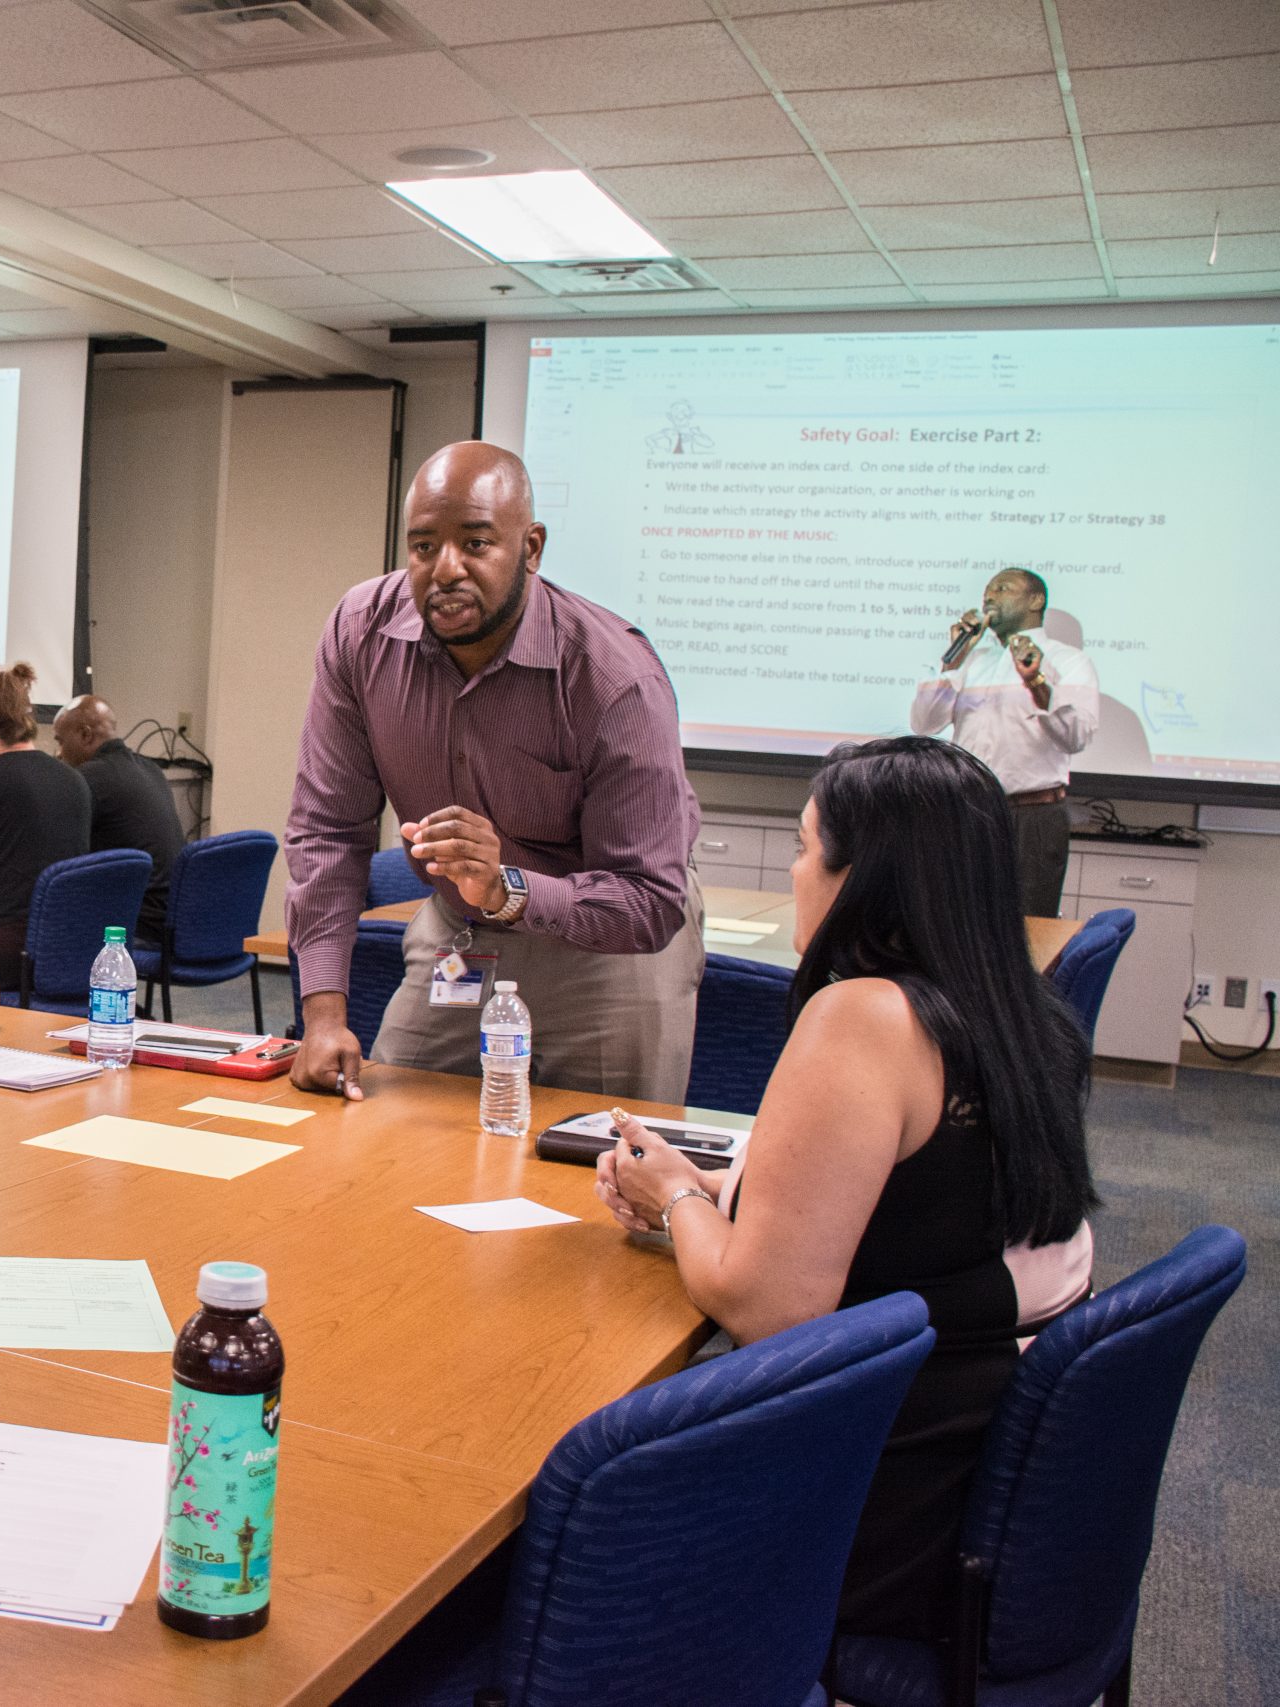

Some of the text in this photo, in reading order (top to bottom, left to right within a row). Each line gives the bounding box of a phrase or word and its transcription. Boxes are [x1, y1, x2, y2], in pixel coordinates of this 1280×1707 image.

[800, 427, 1041, 446] Safety Goal: Exercise Part 2:
[646, 460, 1050, 475] Everyone will receive an index card. On one side of the index card:
[666, 481, 1035, 501] Write the activity your organization, or another is working on
[664, 504, 709, 515] Indicate
[712, 505, 747, 516] which
[750, 507, 797, 520] strategy
[801, 507, 821, 518] the
[823, 507, 868, 522] activity
[871, 508, 906, 523] aligns
[945, 510, 984, 521] either
[990, 511, 1046, 526] Strategy
[1049, 512, 1065, 523] 17
[1068, 515, 1083, 523] or
[1087, 513, 1144, 528] Strategy
[1148, 514, 1166, 525] 38
[641, 526, 838, 542] ONCE PROMPTED BY THE MUSIC:
[660, 549, 677, 560] Go
[680, 551, 692, 561] to
[695, 553, 748, 562] someone
[752, 552, 775, 563] else
[778, 553, 789, 564] in
[792, 553, 812, 564] the
[855, 555, 913, 567] introduce
[918, 557, 968, 572] yourself
[971, 558, 995, 570] and
[1036, 560, 1054, 572] off
[1058, 564, 1088, 576] your
[659, 572, 711, 584] Continue
[714, 575, 726, 585] to
[729, 574, 758, 586] hand
[761, 575, 779, 587] off
[782, 576, 801, 587] the
[804, 577, 830, 588] card
[834, 578, 861, 590] until
[864, 579, 883, 590] the
[888, 580, 924, 592] music
[927, 582, 961, 596] stops
[657, 595, 683, 606] Now
[686, 596, 712, 607] read
[715, 597, 734, 608] the
[737, 597, 763, 609] card
[767, 599, 788, 610] and
[792, 602, 823, 611] score
[827, 601, 856, 613] from
[860, 602, 867, 613] 1
[870, 604, 883, 614] to
[902, 604, 930, 615] with
[934, 605, 941, 616] 5
[655, 617, 689, 629] Music
[692, 619, 729, 634] begins
[770, 622, 822, 635] continue
[826, 625, 871, 641] passing
[874, 627, 895, 639] the
[898, 628, 925, 640] card
[928, 630, 950, 641] unt
[725, 643, 746, 654] and
[750, 644, 789, 656] SCORE
[689, 663, 747, 677] instructed
[808, 669, 828, 681] the
[831, 671, 860, 683] total
[863, 675, 895, 685] score
[898, 677, 915, 686] on
[166, 1539, 193, 1558] reen
[193, 1542, 225, 1564] Tea
